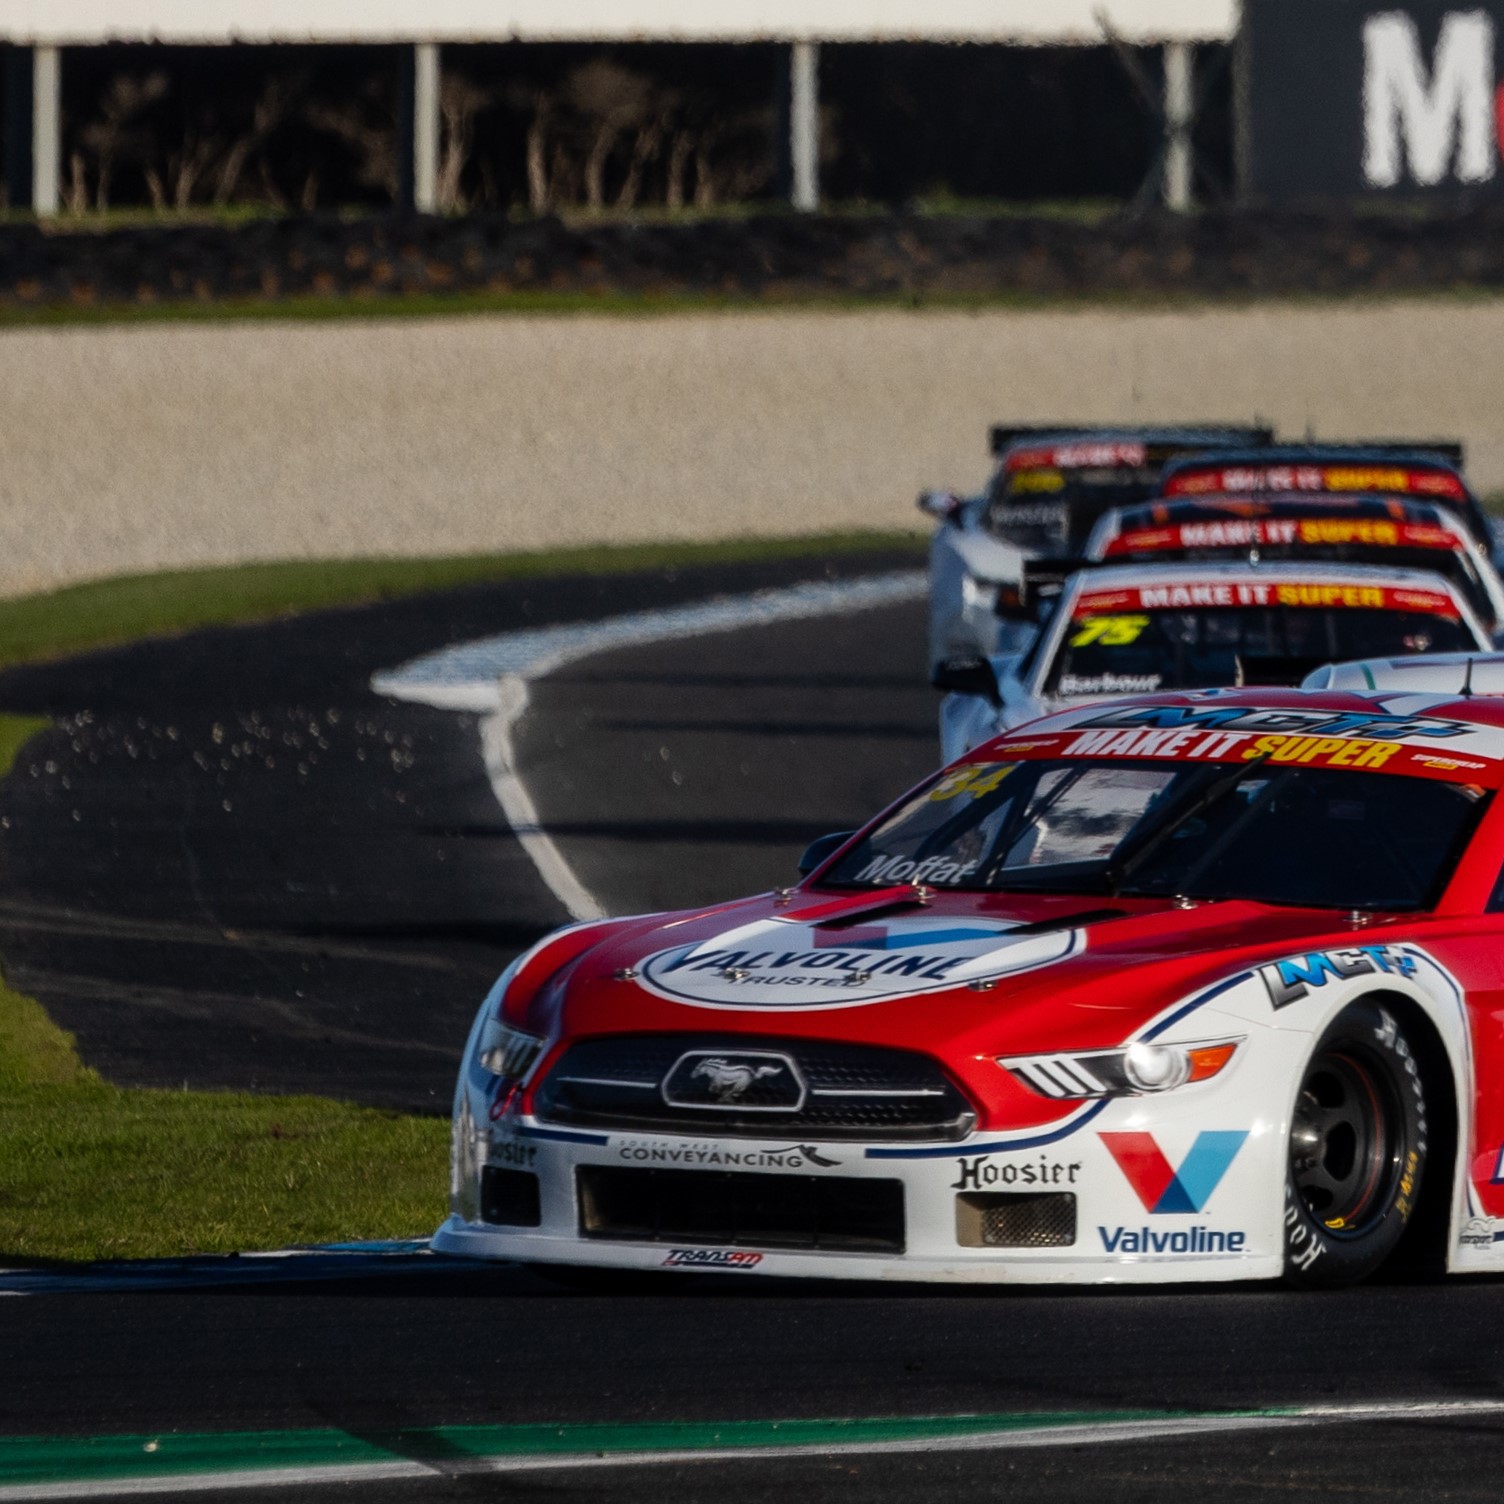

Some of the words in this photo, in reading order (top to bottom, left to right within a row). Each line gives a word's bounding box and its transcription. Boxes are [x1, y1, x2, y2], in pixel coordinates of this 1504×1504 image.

[1140, 585, 1233, 608] MAKE
[1236, 584, 1271, 605] IT
[1277, 584, 1384, 607] SUPER
[1069, 615, 1150, 646] 75
[1061, 730, 1199, 756] MAKE
[1187, 731, 1252, 759] IT
[1241, 736, 1403, 768] SUPER
[929, 761, 1017, 801] 34
[854, 855, 979, 884] Moffat
[661, 948, 980, 981] VALVOLINE
[619, 1147, 804, 1168] CONVEYANCING
[950, 1155, 1083, 1190] Hoosier
[1097, 1225, 1246, 1253] Valvoline
